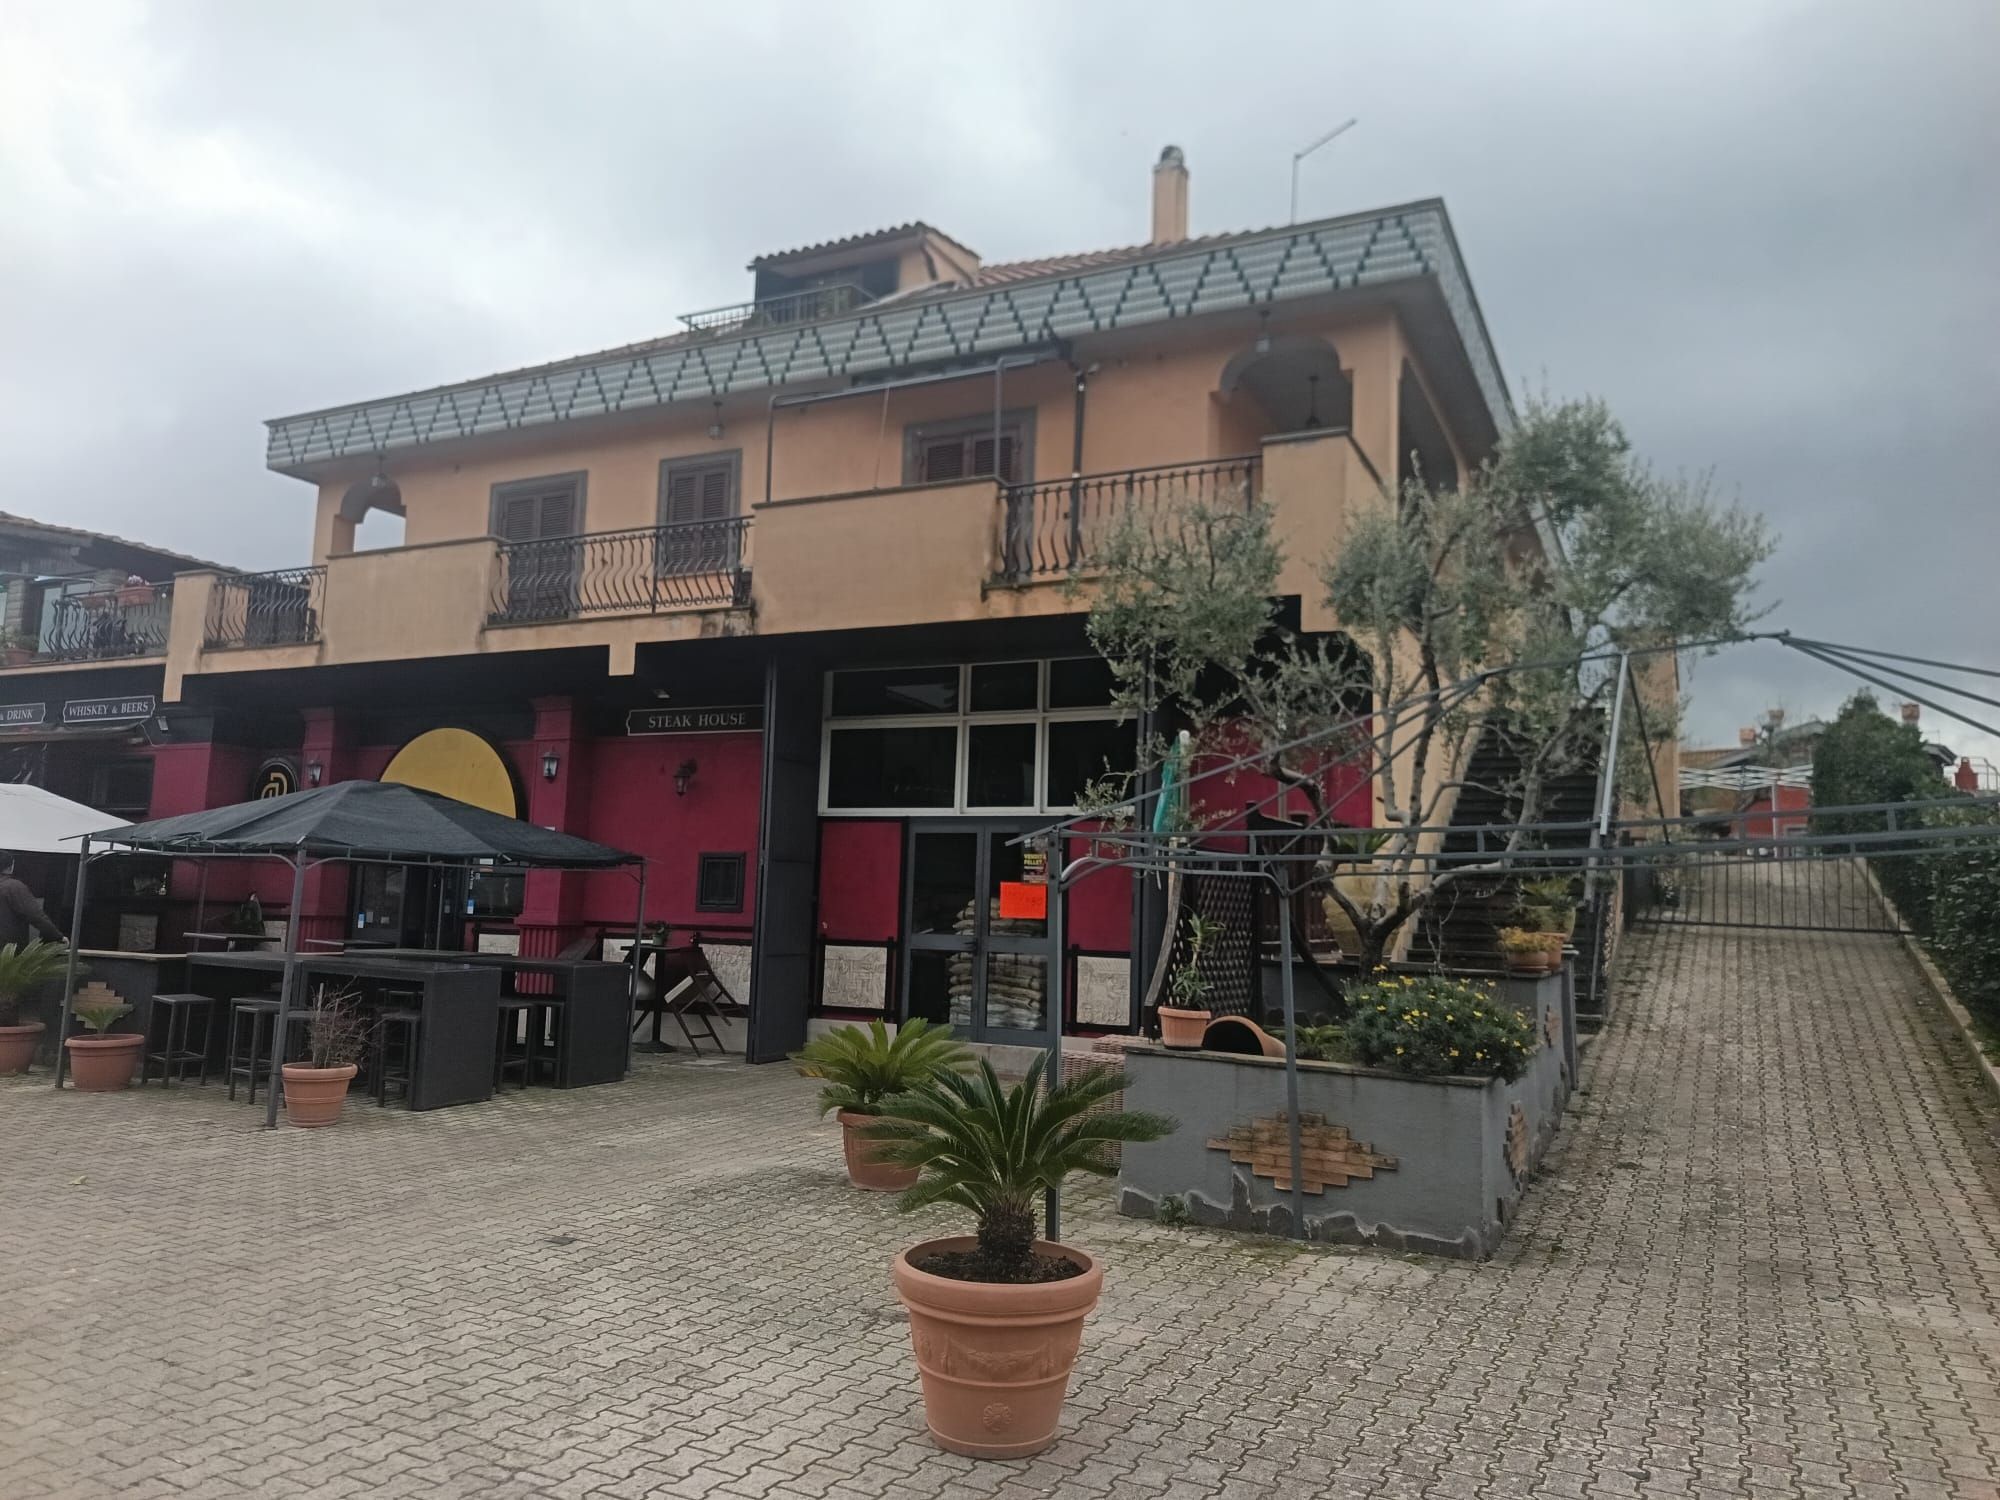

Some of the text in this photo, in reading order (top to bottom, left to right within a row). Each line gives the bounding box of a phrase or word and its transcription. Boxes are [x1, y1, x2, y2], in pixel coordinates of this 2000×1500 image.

[7, 709, 33, 721] DRINK
[69, 702, 149, 716] WHISKEY & BEERS
[648, 712, 746, 728] STEAK HOUSE
